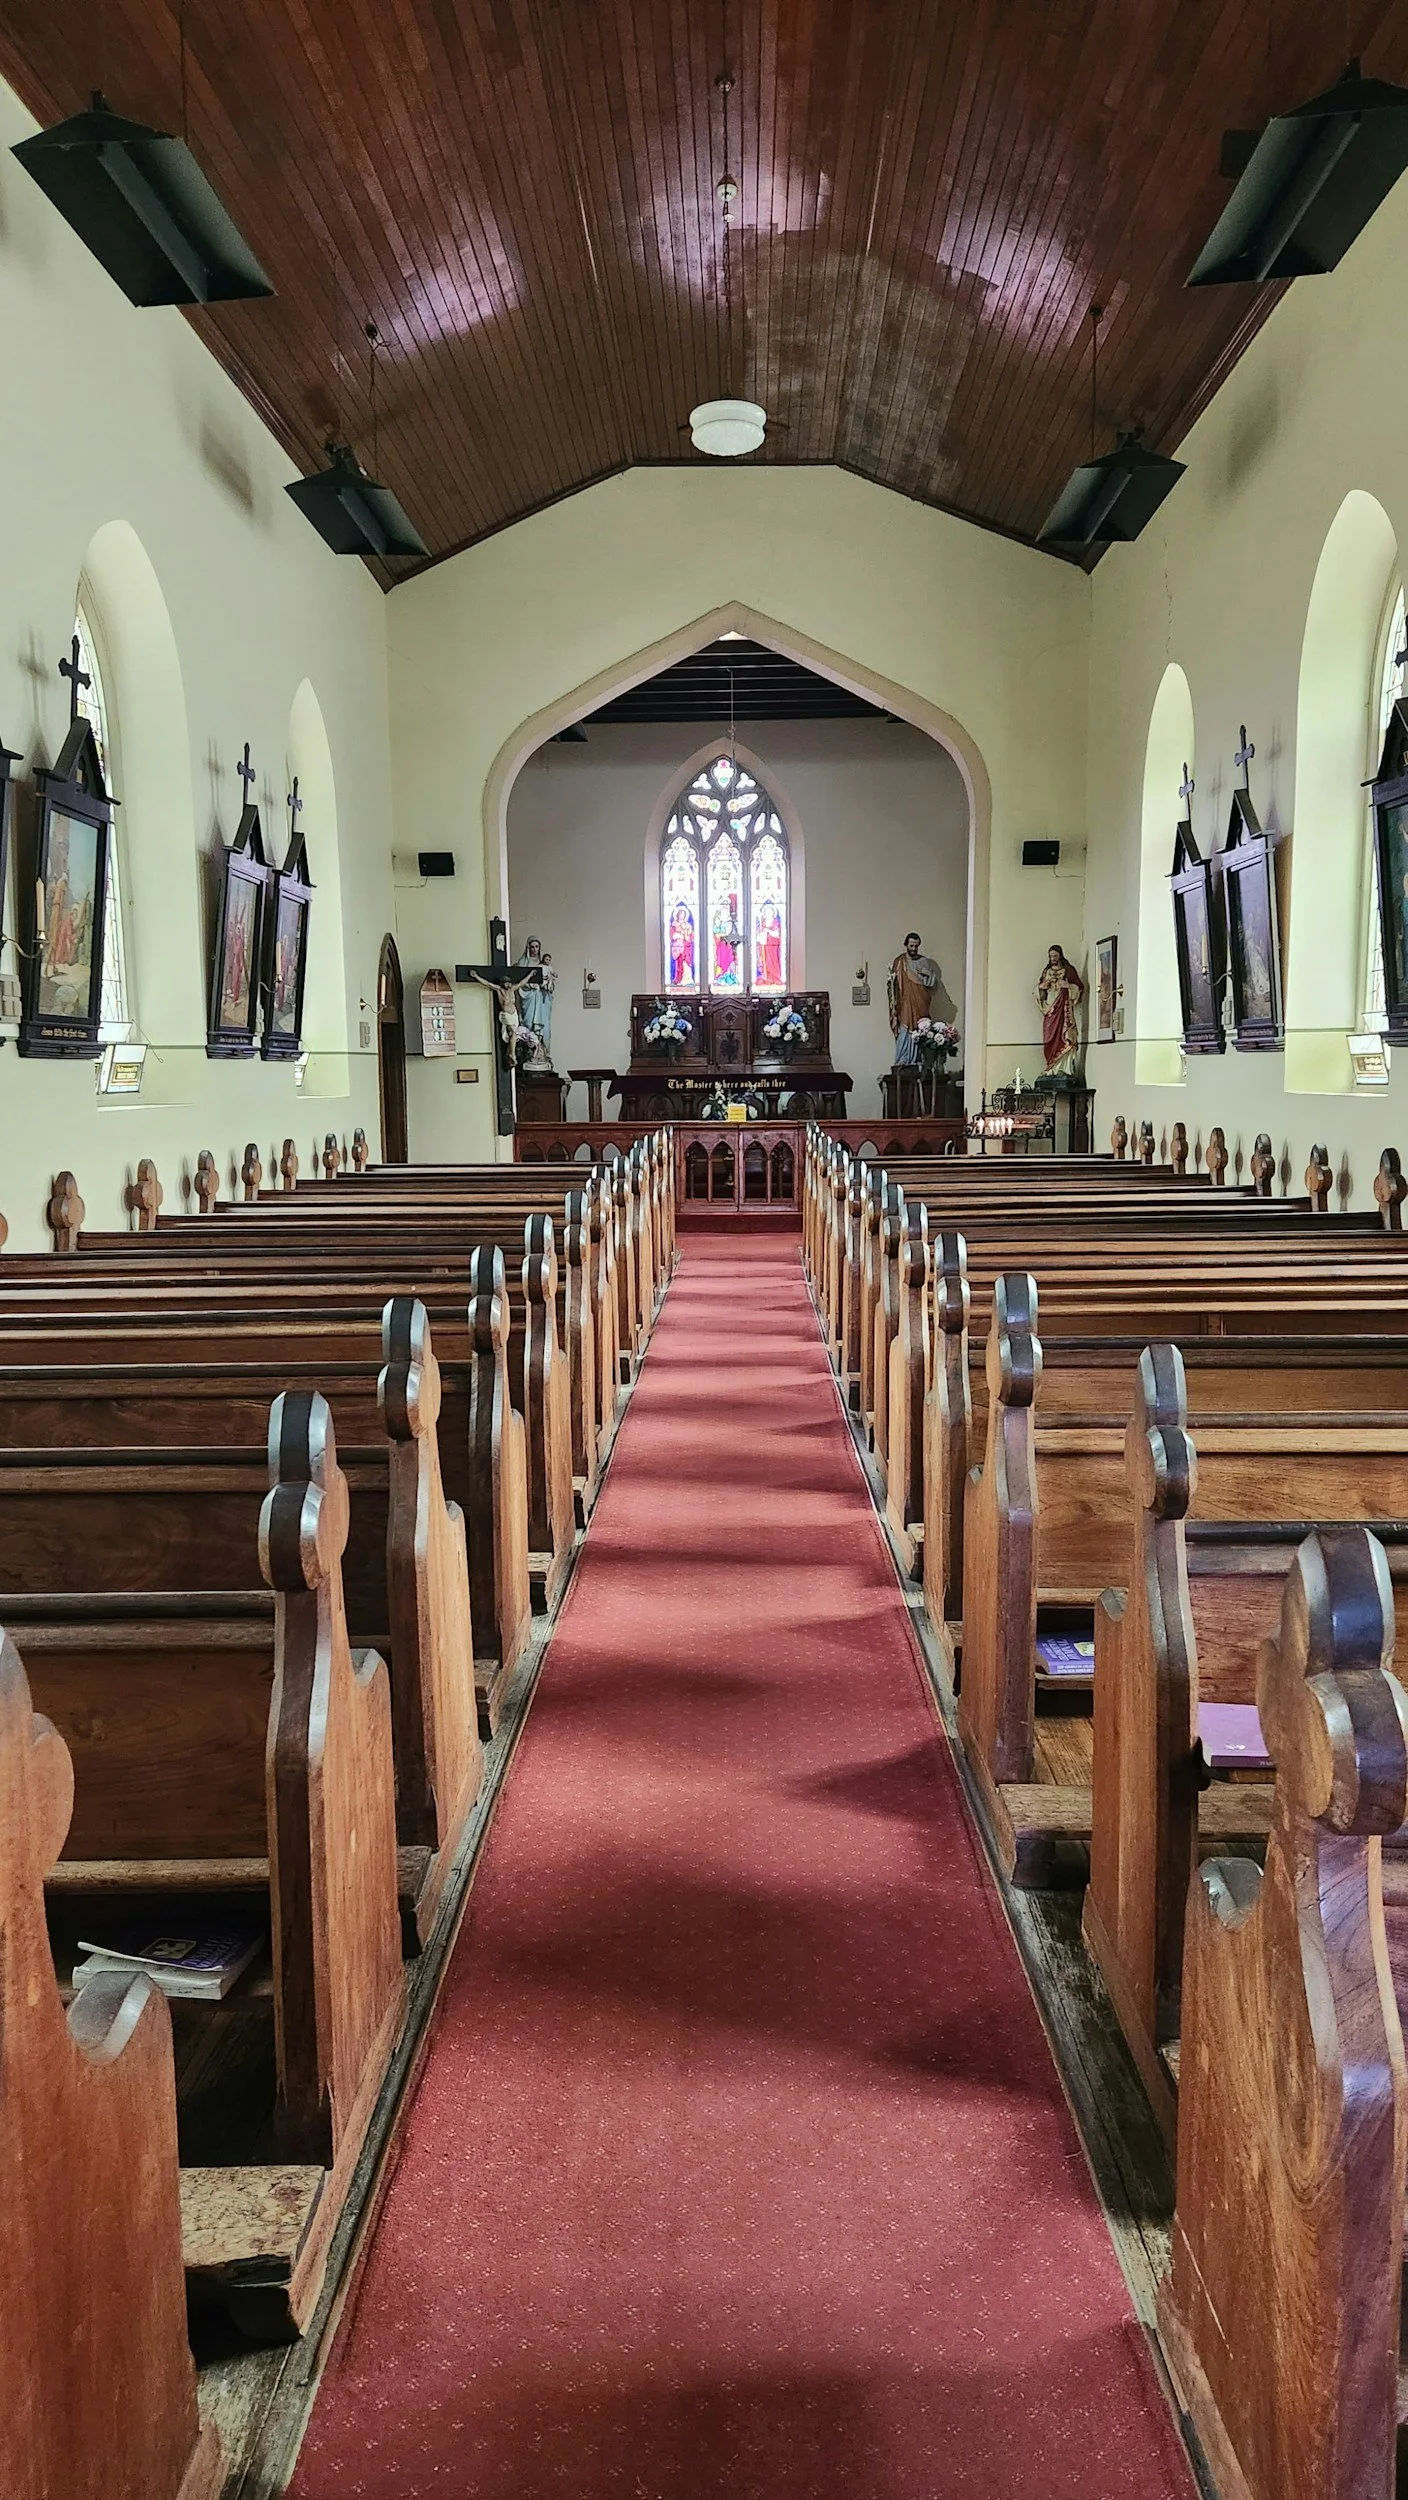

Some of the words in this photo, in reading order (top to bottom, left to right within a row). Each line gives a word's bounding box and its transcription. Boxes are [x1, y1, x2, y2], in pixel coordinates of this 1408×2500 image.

[667, 1079, 684, 1089] The
[685, 1079, 712, 1089] Master
[722, 1079, 738, 1089] here
[771, 1078, 786, 1088] thee
